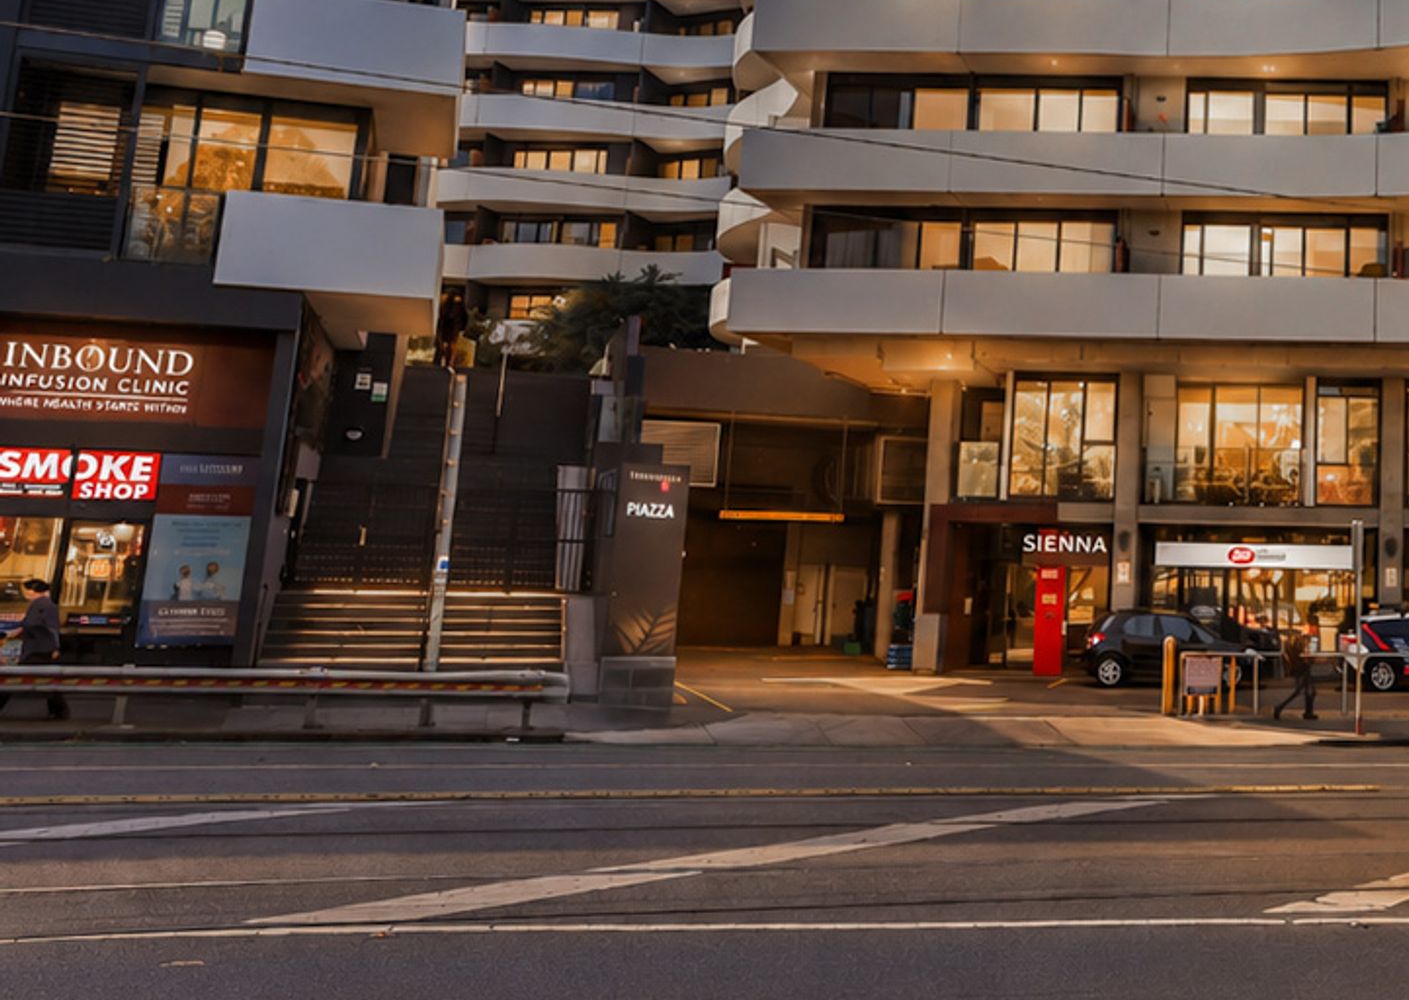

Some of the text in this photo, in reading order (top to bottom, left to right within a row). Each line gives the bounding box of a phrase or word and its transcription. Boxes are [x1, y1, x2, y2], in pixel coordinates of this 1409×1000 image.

[3, 341, 194, 376] INBOUND
[0, 373, 190, 395] INFUSION CLINIC
[0, 450, 153, 482] SMOKE
[79, 482, 149, 499] SHOP
[626, 502, 675, 519] PIAZZA
[1022, 534, 1107, 553] SIENNA
